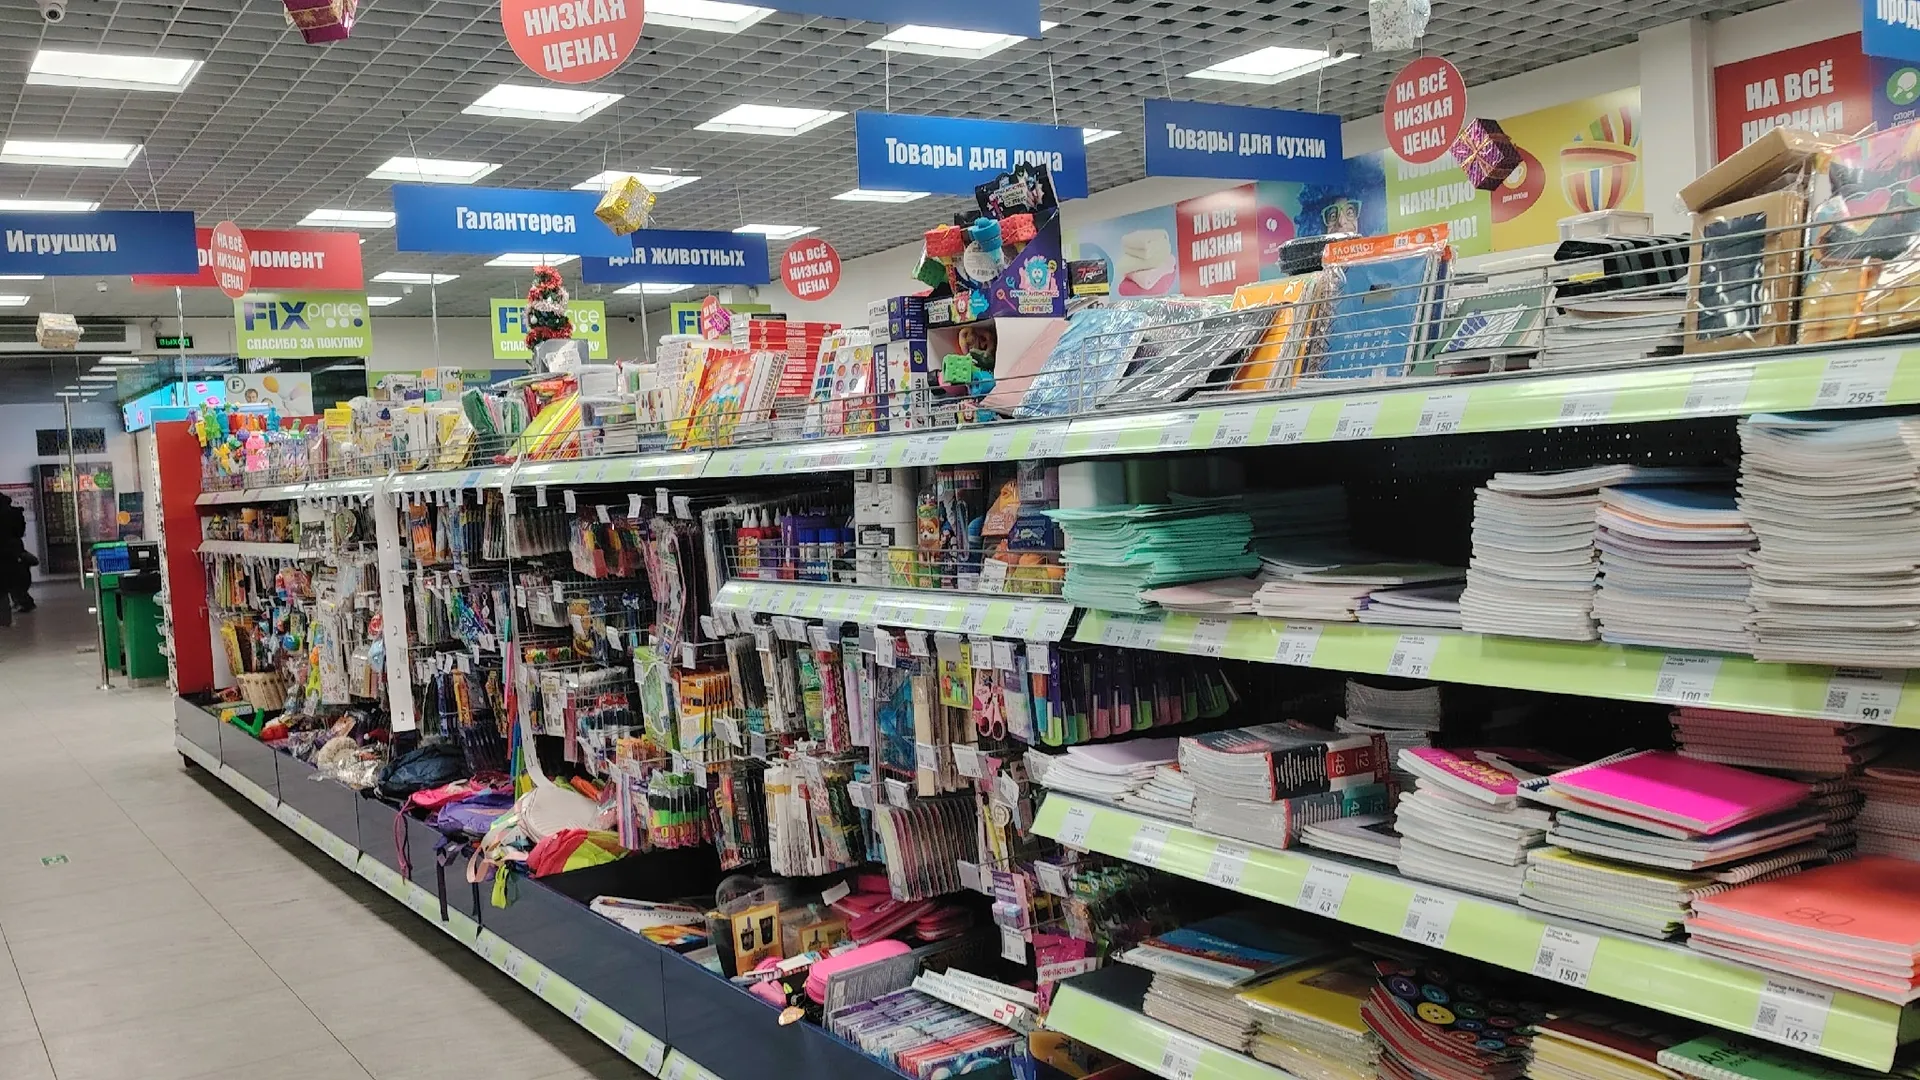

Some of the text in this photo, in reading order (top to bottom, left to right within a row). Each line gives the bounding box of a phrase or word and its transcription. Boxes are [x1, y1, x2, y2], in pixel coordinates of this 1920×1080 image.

[523, 0, 627, 37] НИЗКАЯ
[542, 33, 618, 73] ЦЕНА!
[1395, 66, 1448, 103] НА ВСЁ
[1745, 59, 1835, 112] НА ВСЁ
[1393, 96, 1453, 131] НИЗКАЯ
[1165, 123, 1326, 160] Товары для кухни
[1402, 125, 1446, 157] ЦЕНА!
[885, 137, 963, 169] Товары
[968, 146, 1007, 171] для
[1400, 181, 1476, 216] КАЖДУЮ
[456, 206, 577, 235] Галантерея
[1193, 214, 1211, 235] НА
[6, 229, 117, 255] Игрушки
[217, 233, 228, 248] НА
[1191, 231, 1242, 261] НИЗКАЯ
[217, 253, 246, 273] НИЗКАЯ
[650, 247, 745, 267] животных
[788, 243, 828, 265] НА ВСЁ
[789, 260, 833, 279] НИЗКАЯ
[1198, 260, 1236, 288] ЦЕНА!
[221, 273, 244, 291] ЦЕНА!
[797, 279, 830, 296] ЦЕНА!
[307, 302, 362, 321] price
[247, 336, 364, 350] СПАСИБО ЗА ПОКУПКУ
[1847, 391, 1876, 404] 295
[1351, 428, 1366, 437] 112
[1435, 422, 1452, 432] 150
[1293, 653, 1304, 663] 21
[1410, 665, 1421, 675] 75
[1862, 707, 1880, 720] 90
[1335, 753, 1346, 775] 48
[1319, 900, 1331, 913] 43
[1425, 930, 1437, 943] 75
[1558, 968, 1579, 983] 150
